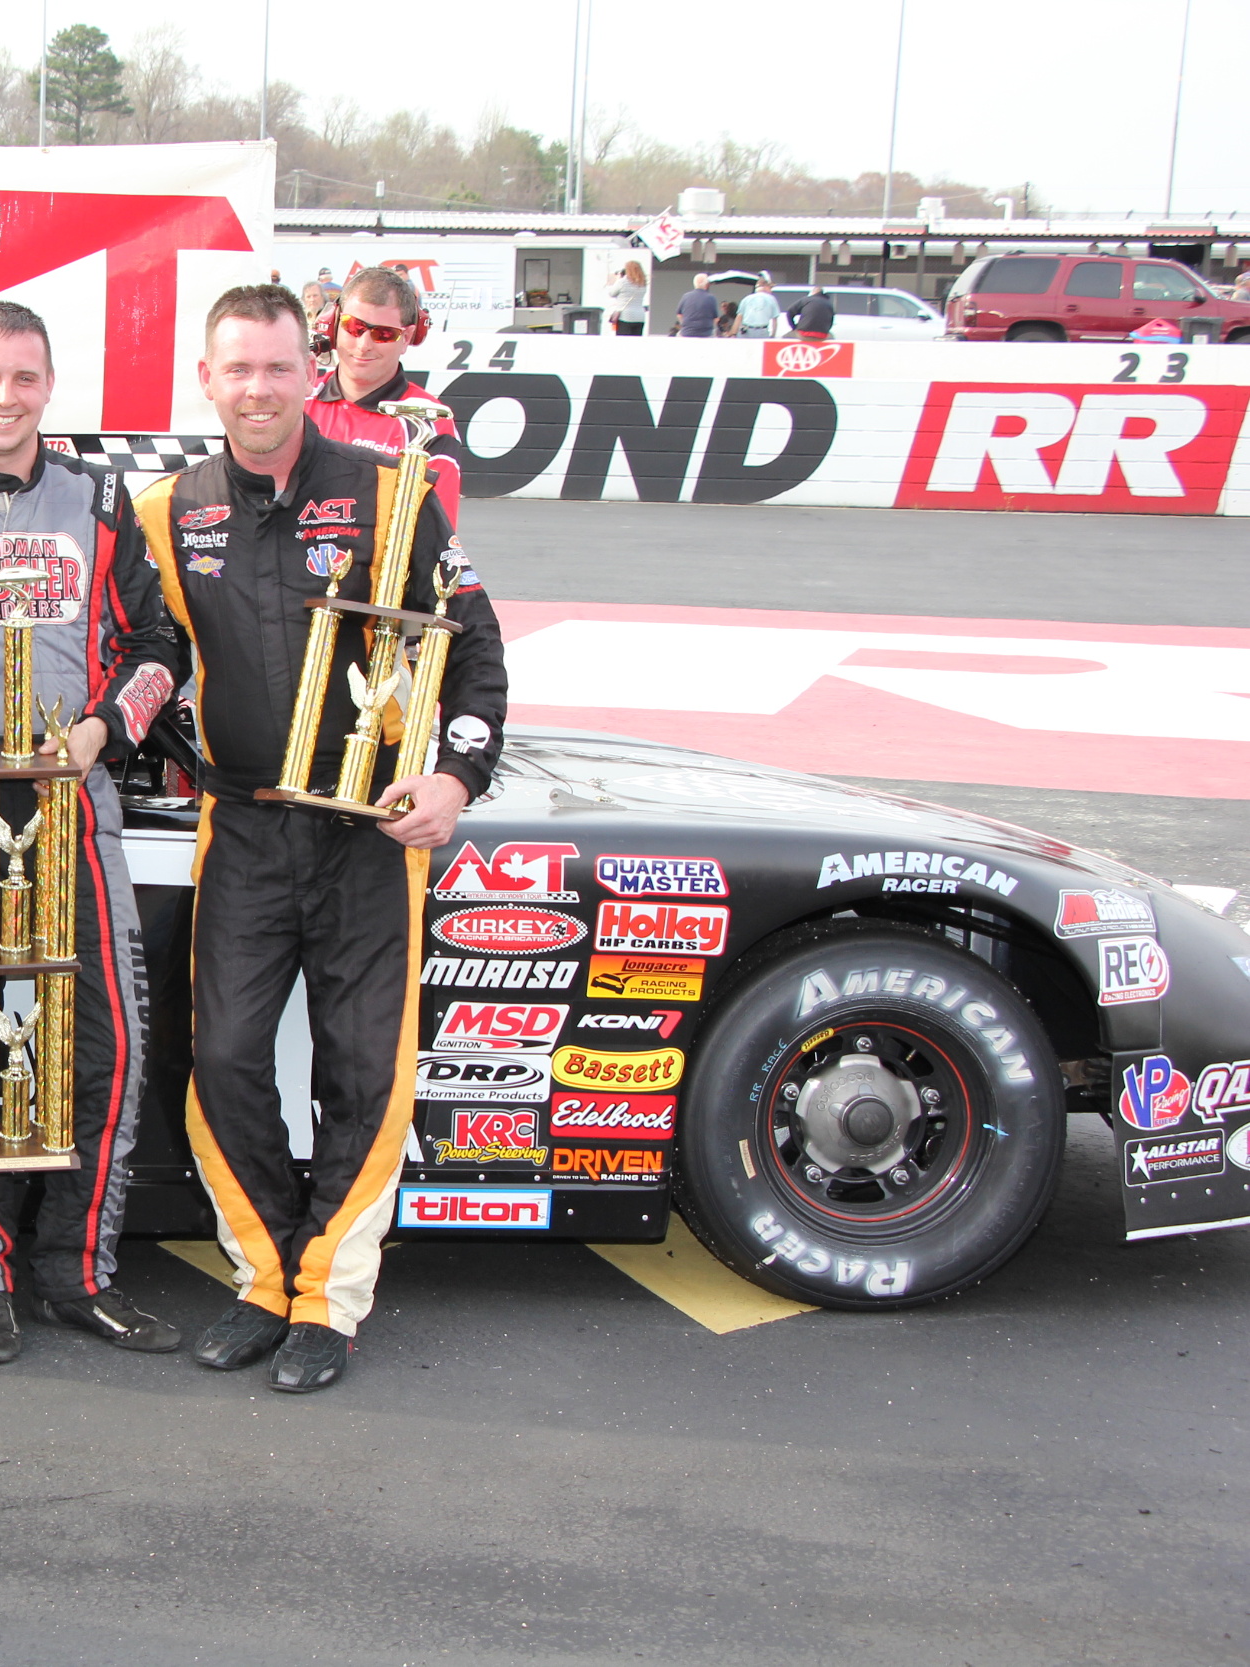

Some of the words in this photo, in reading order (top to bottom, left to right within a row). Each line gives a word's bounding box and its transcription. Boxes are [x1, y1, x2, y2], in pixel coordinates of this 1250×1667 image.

[422, 302, 448, 310] TOCK
[780, 346, 819, 370] AAA
[351, 438, 399, 456] Official
[406, 371, 838, 504] OND
[101, 473, 115, 514] sparco
[181, 530, 229, 548] Hoosier
[302, 526, 362, 541] AMERICAN
[436, 842, 579, 892] ACT
[599, 858, 715, 882] QUARTER
[817, 851, 1018, 896] AMERICAN
[620, 875, 720, 893] MASTER
[882, 878, 957, 893] RACER
[453, 918, 553, 934] KIRKEY
[601, 904, 723, 951] Holley
[600, 938, 625, 947] HP
[631, 939, 698, 950] CARBS
[420, 957, 579, 988] MOROSO
[621, 958, 688, 974] Longacre
[630, 988, 696, 996] PRODUCTS
[640, 980, 687, 988] RACING
[443, 1004, 561, 1038] MSD
[797, 967, 1034, 1081] AMERICAN
[435, 1040, 482, 1049] IGNITION
[426, 1062, 528, 1082] DRP
[563, 1053, 675, 1083] Bassett
[414, 1089, 485, 1099] erformance
[489, 1091, 543, 1100] Products
[1123, 1055, 1172, 1128] VP
[1154, 1088, 1189, 1118] Racing
[552, 1099, 673, 1130] Edelbrock
[1154, 1116, 1179, 1126] FUELS
[454, 1111, 536, 1149] KRC
[435, 1140, 484, 1163] Power
[479, 1141, 547, 1165] Steering
[1147, 1138, 1219, 1159] ALLSTAR
[552, 1148, 663, 1180] DRIVEN
[1147, 1153, 1220, 1171] PERFORMANCE
[410, 1195, 540, 1222] tilton
[753, 1210, 911, 1297] RACER
